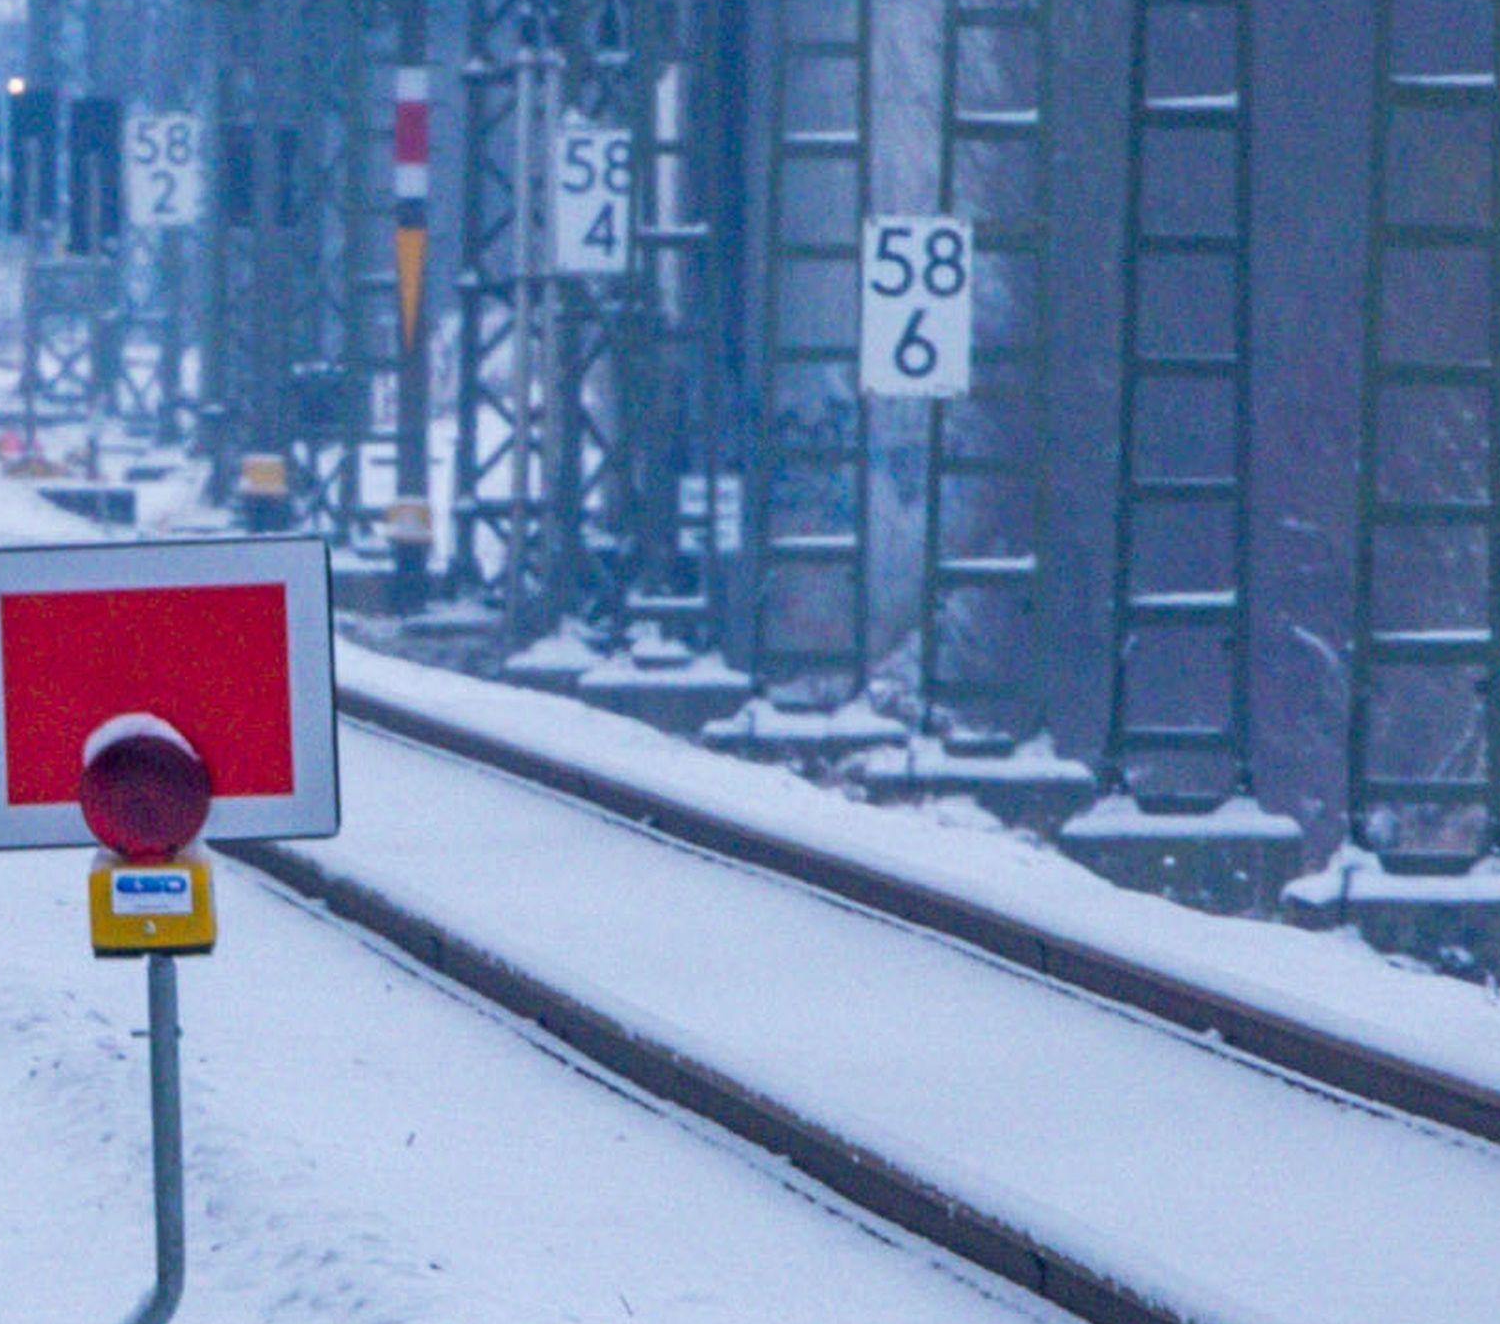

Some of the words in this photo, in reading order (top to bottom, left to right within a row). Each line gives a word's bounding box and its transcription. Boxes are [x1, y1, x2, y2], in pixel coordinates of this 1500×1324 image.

[134, 120, 192, 165] 58
[562, 137, 632, 194] 58
[151, 170, 178, 215] 2
[582, 203, 620, 257] 4
[869, 226, 966, 298] 58
[894, 308, 938, 379] 6
